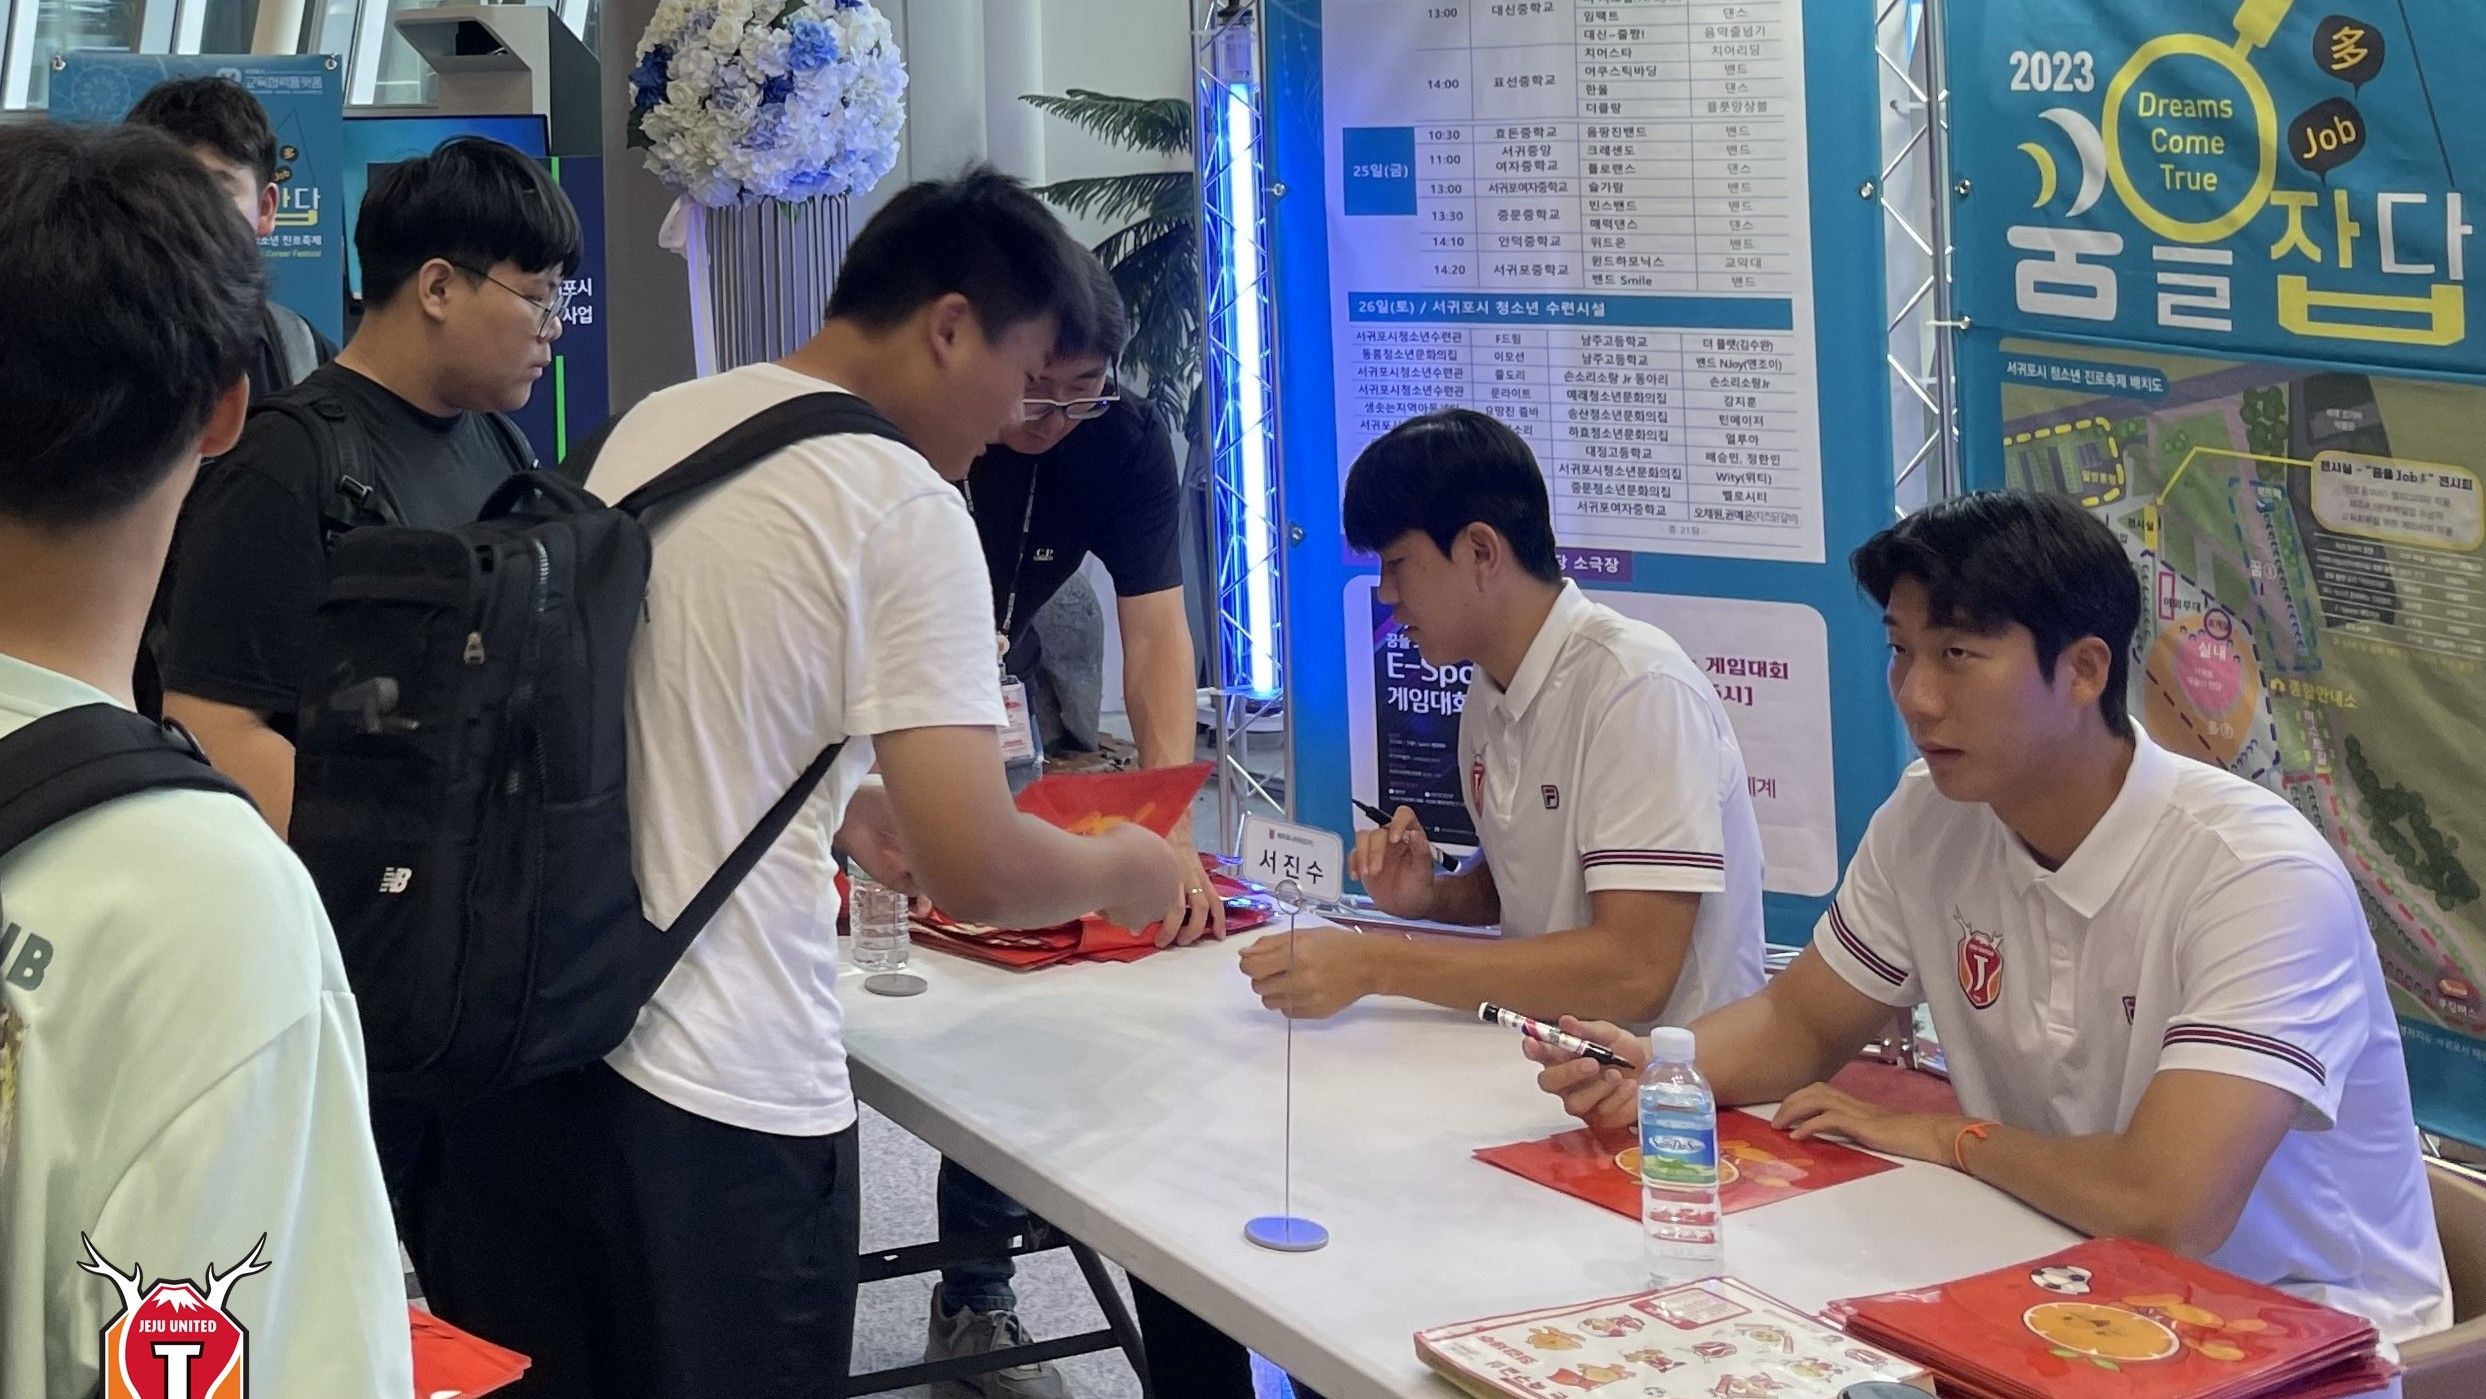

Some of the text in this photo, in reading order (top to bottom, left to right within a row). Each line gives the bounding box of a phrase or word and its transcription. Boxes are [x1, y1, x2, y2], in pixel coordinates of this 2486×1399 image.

[1428, 8, 1458, 18] 13:00
[1491, 2, 1555, 16] 대신중학교
[1723, 8, 1748, 19] 댄스
[1584, 11, 1619, 22] 임팩트
[1705, 26, 1766, 38] 음악줄넘기
[1585, 48, 1632, 59] 치어스타
[1712, 45, 1761, 56] 치어리딩
[1724, 64, 1749, 75] 밴드
[2009, 50, 2095, 92] 2023
[1428, 79, 1459, 89] 14:00
[1493, 74, 1557, 88] 표선중학교
[1725, 83, 1749, 94] 댄스
[2138, 91, 2233, 119] Dreams
[1429, 130, 1460, 141] 10:30
[1496, 127, 1558, 139] 효돈중학교
[1726, 126, 1750, 137] 밴드
[2303, 115, 2357, 159] Job
[2152, 128, 2225, 155] Come
[1502, 145, 1552, 157] 서귀중앙
[1587, 145, 1635, 156] 크레센도
[1727, 144, 1751, 155] 밴드
[1430, 155, 1461, 165] 11:00
[1496, 160, 1559, 172] 여자중학교
[1353, 164, 1408, 178] 25일(금)
[1727, 163, 1752, 174] 댄스
[2160, 164, 2218, 192] True
[1431, 184, 1462, 194] 13:00
[1489, 181, 1568, 193] 서귀포여자중학교
[1728, 182, 1752, 193] 밴드
[1589, 201, 1638, 211] 빈스밴드
[1729, 201, 1753, 212] 밴드
[1432, 211, 1463, 221] 13:30
[1498, 208, 1560, 221] 중문중학교
[1590, 219, 1638, 230] 매력댄스
[1729, 219, 1754, 231] 댄스
[1433, 237, 1465, 247] 14:10
[1499, 235, 1561, 248] 안덕중학교
[1730, 239, 1754, 250] 밴드
[1434, 265, 1465, 275] 14:20
[1494, 264, 1569, 276] 서귀포중학교
[1592, 274, 1652, 286] 밴드 Smile
[1732, 276, 1757, 288] 밴드
[1358, 300, 1415, 316] 26일(토)
[1432, 299, 1490, 315] 서귀포시
[1495, 300, 1539, 317] 청소년
[1545, 302, 1606, 319] 수련시설
[1356, 330, 1462, 342] 서귀포시청소년수련관
[1581, 334, 1648, 347] 남주고등학교
[1703, 338, 1713, 349] 더
[1494, 351, 1525, 362] 이모션
[1582, 353, 1648, 366] 남주고등학교
[1696, 357, 1717, 369] 밴드
[1357, 366, 1463, 379] 서귀포시청소년수련관
[2007, 361, 2164, 392] 서귀포시 청소년 진로축제 배치도
[1635, 373, 1668, 386] 동아리
[1358, 384, 1464, 397] 서귀포시청소년수련관
[1491, 387, 1531, 398] 문라이트
[1586, 446, 1653, 460] 대정고등학교
[1559, 463, 1682, 480] 서귀포시청소년문화의집
[1571, 481, 1671, 498] 중문청소년문화의집
[1577, 501, 1667, 517] 서귀포여자중학교
[1574, 555, 1620, 573] 소극장
[2199, 641, 2227, 660] 실내
[1706, 657, 1788, 680] 게임대회
[1259, 849, 1323, 884] 서진수
